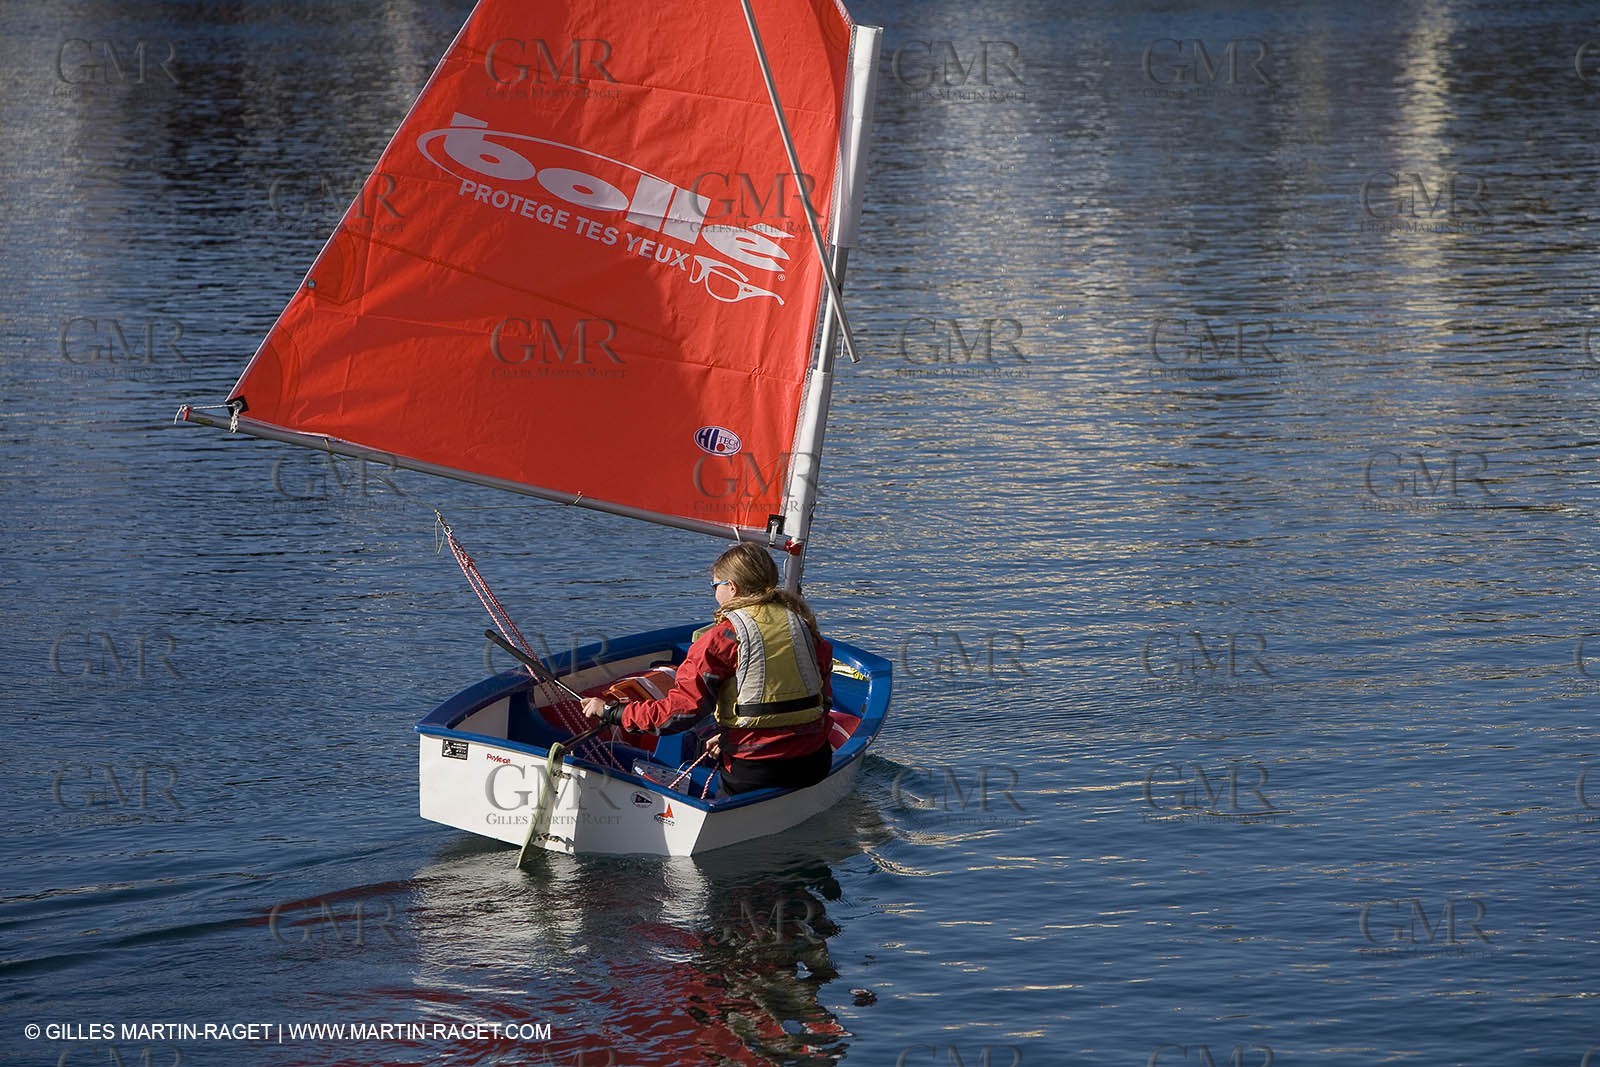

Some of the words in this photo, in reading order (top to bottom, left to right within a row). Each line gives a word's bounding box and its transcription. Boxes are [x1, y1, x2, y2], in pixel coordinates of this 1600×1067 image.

[458, 178, 568, 230] PROTEGE
[575, 215, 618, 246] TES
[625, 234, 691, 272] YEUX
[698, 428, 720, 451] HI
